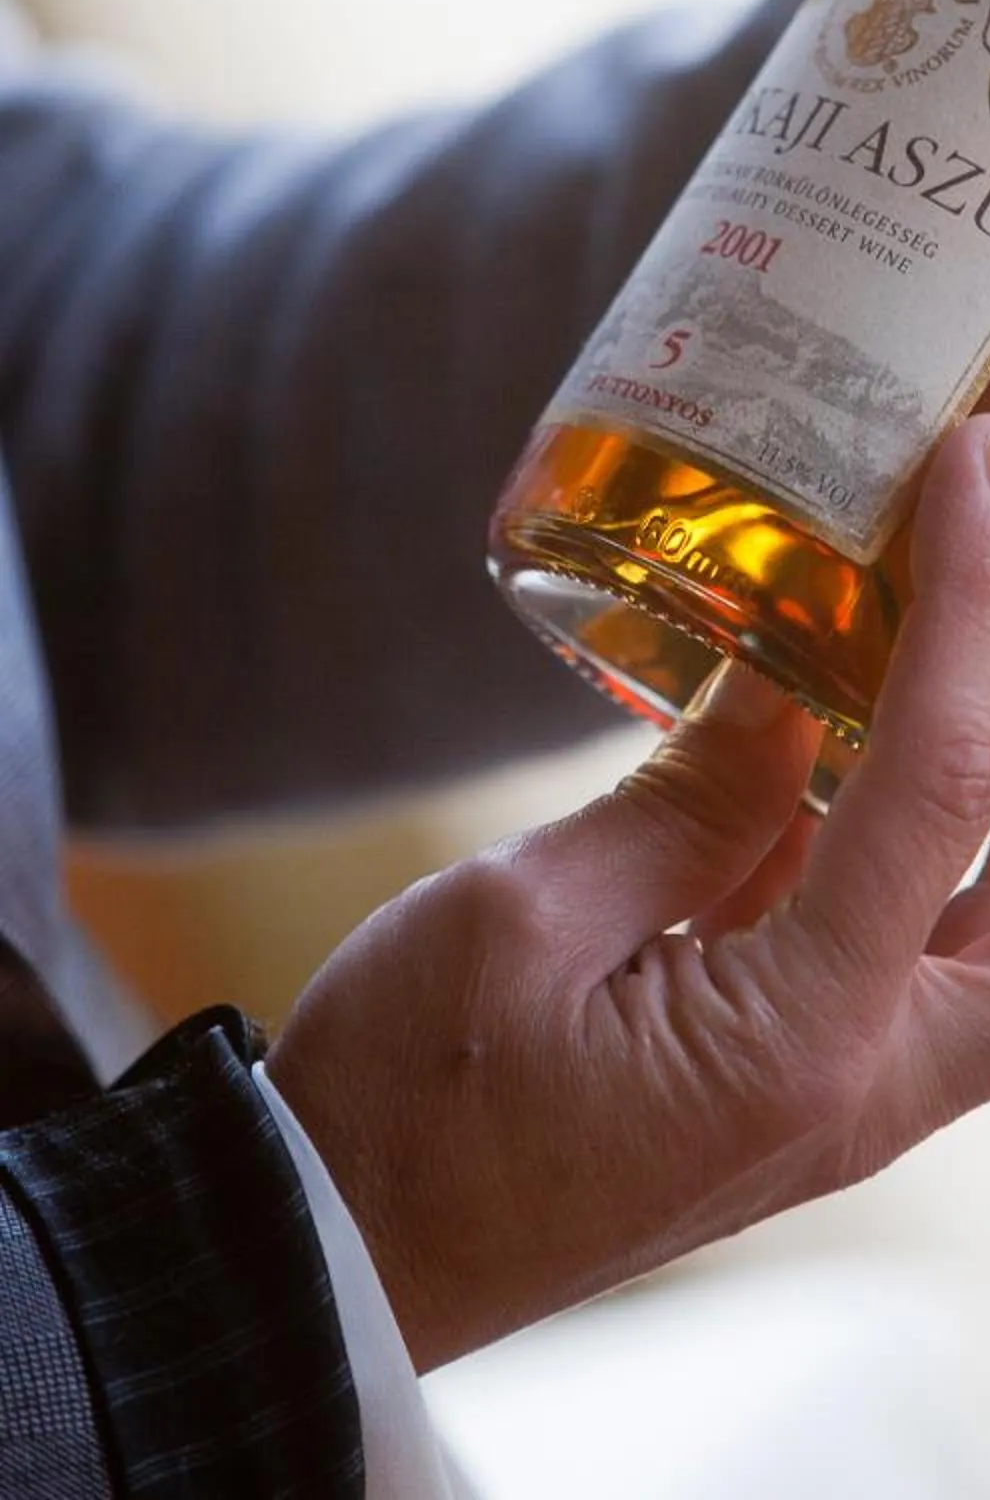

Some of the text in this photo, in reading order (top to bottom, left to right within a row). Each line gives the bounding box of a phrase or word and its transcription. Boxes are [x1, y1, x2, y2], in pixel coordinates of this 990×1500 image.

[893, 17, 976, 88] VINORUM
[700, 219, 783, 274] 2001
[773, 199, 855, 245] DESSERT
[859, 235, 913, 275] WINE
[648, 329, 692, 369] 5
